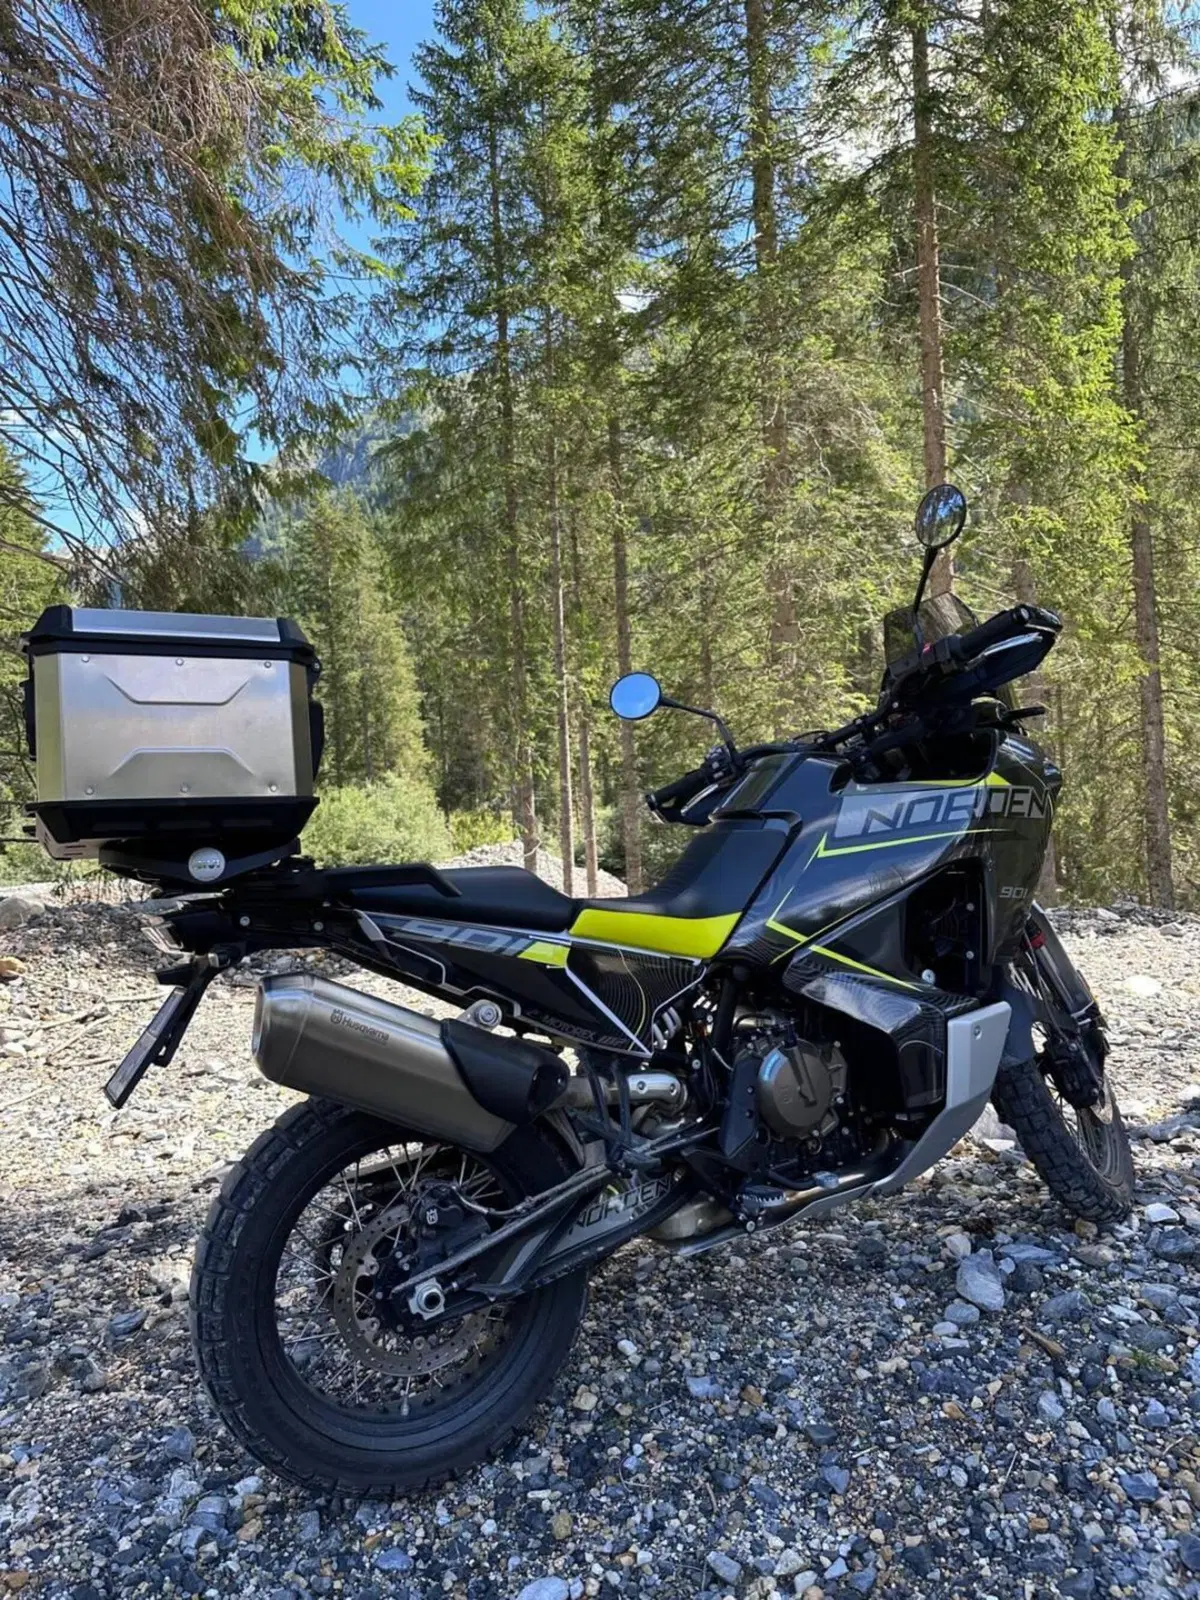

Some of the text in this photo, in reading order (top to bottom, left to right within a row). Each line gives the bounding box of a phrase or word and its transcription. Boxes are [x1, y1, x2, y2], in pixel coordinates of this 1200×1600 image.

[860, 785, 1049, 837] NORDEN
[1000, 885, 1029, 899] 901
[341, 1016, 389, 1041] Husqvarna
